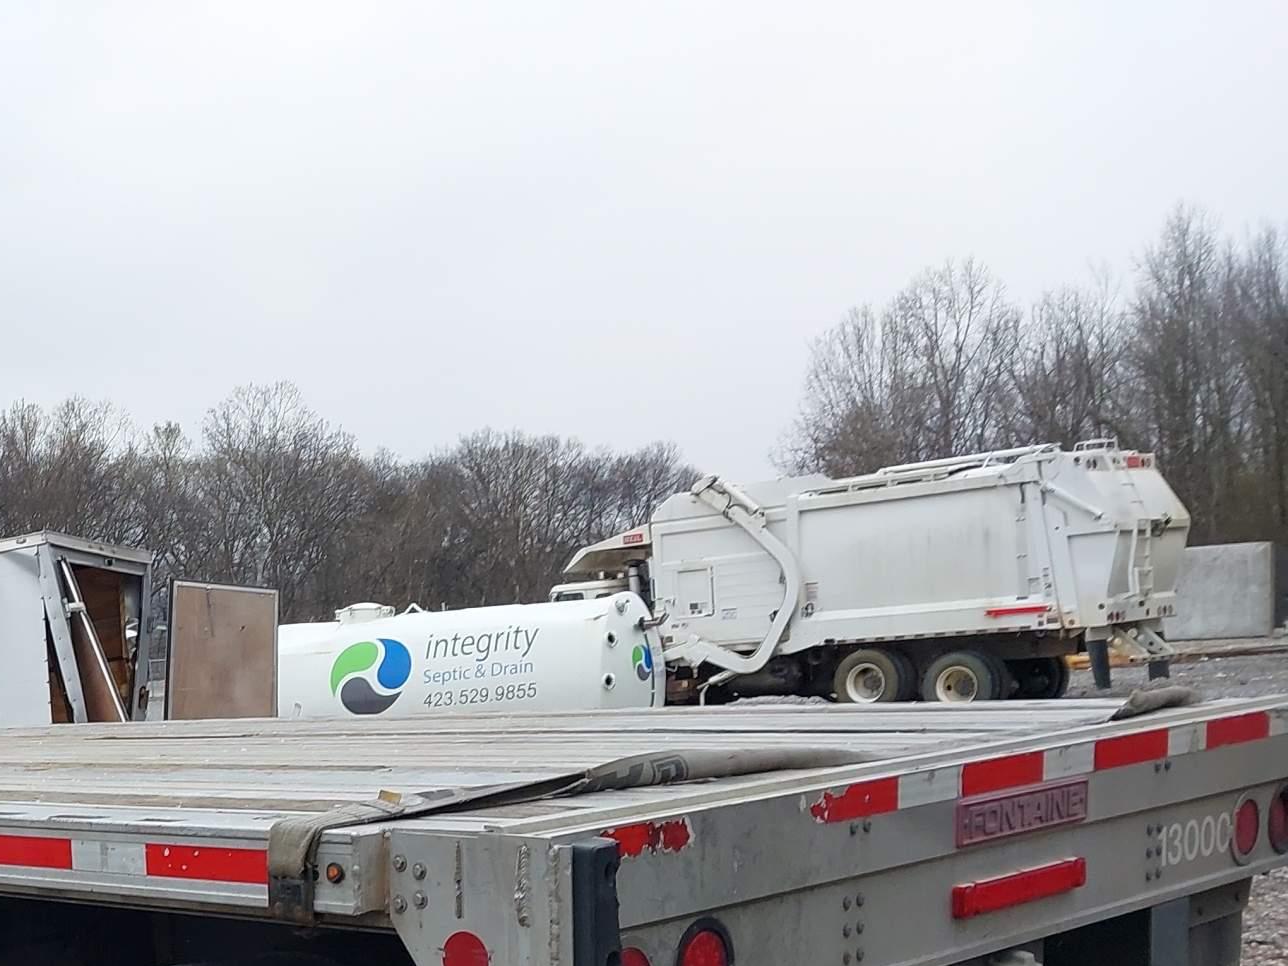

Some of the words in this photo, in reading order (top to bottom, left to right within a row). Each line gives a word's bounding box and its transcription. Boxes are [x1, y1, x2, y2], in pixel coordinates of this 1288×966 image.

[423, 666, 471, 685] Septic
[474, 663, 486, 679] &
[491, 660, 533, 677] Drain
[423, 682, 537, 708] 423.529.9855
[968, 788, 1081, 840] FONTAINE
